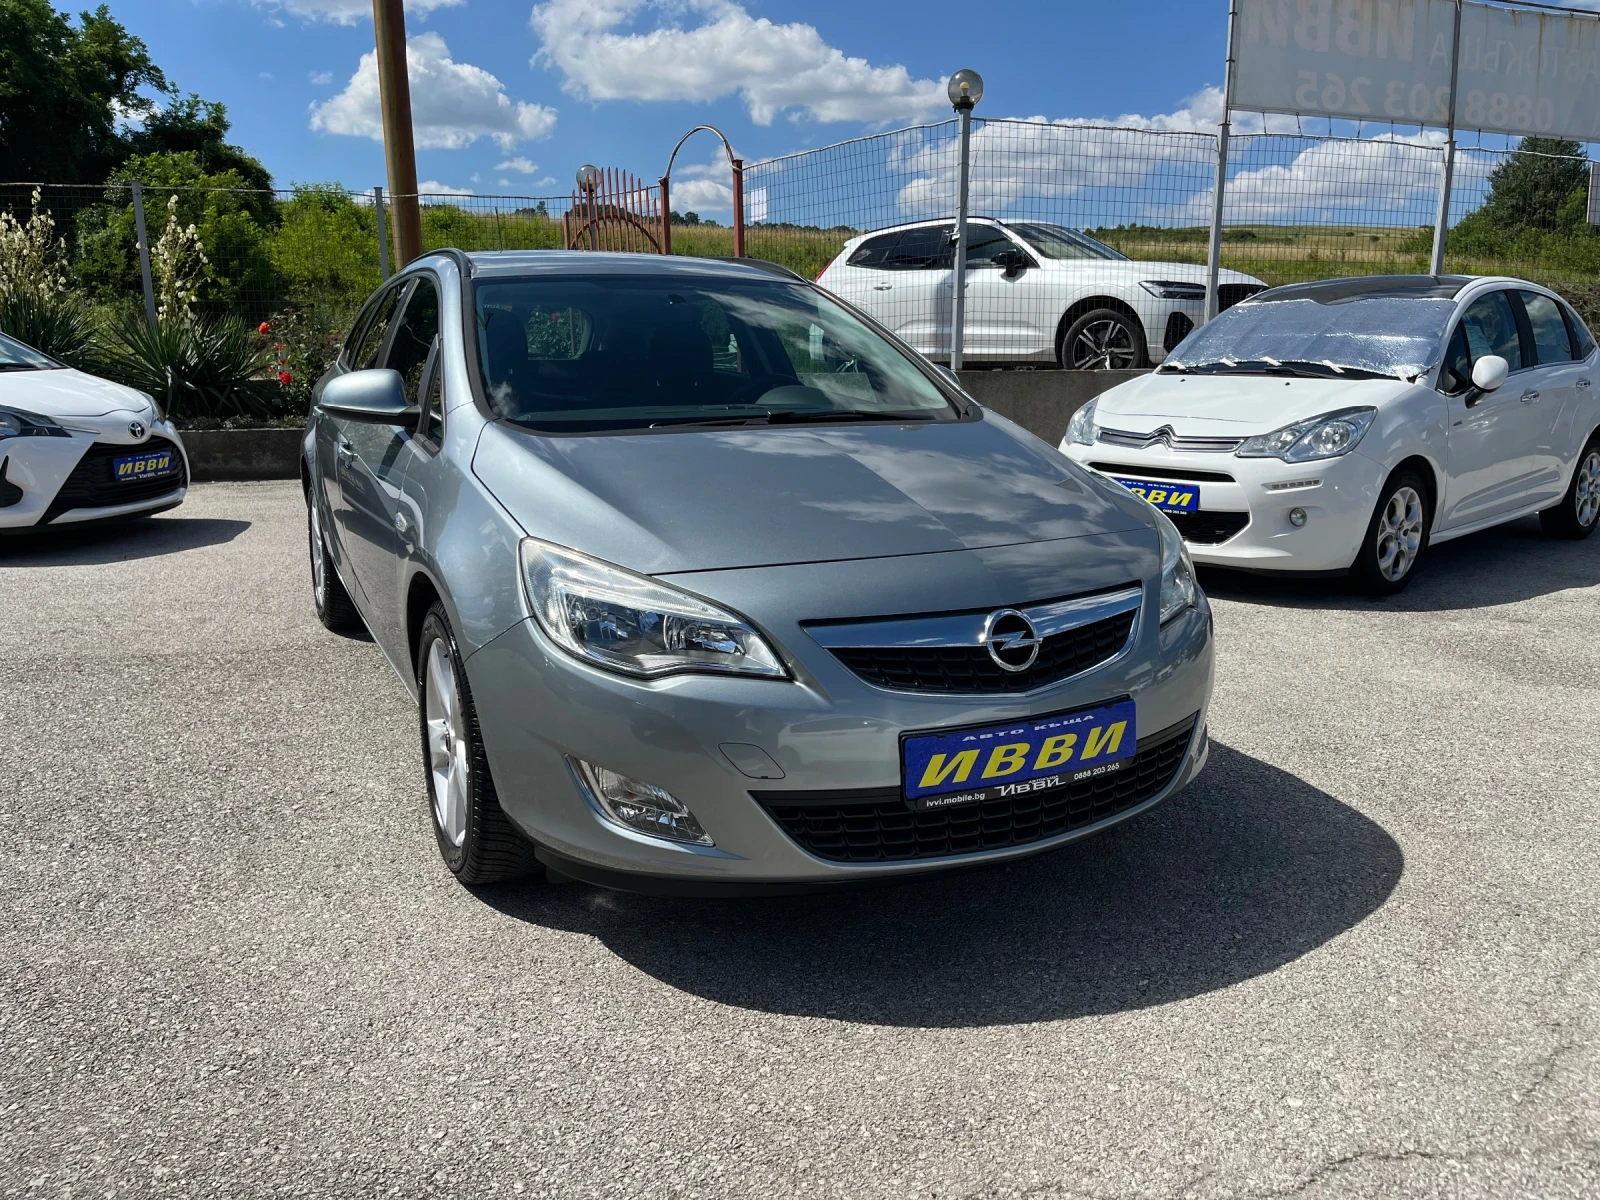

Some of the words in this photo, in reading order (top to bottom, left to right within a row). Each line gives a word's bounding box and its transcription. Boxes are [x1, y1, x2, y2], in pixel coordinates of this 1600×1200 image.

[118, 456, 170, 475] ИВВИ
[962, 728, 1024, 742] АВТО
[1034, 714, 1095, 732] КЪЩА
[918, 720, 1128, 788] ИВВИ
[1073, 769, 1091, 780] 0888
[1092, 766, 1106, 776] 203
[1106, 762, 1120, 772] 265
[926, 792, 986, 808] ivvi.mobile.bg
